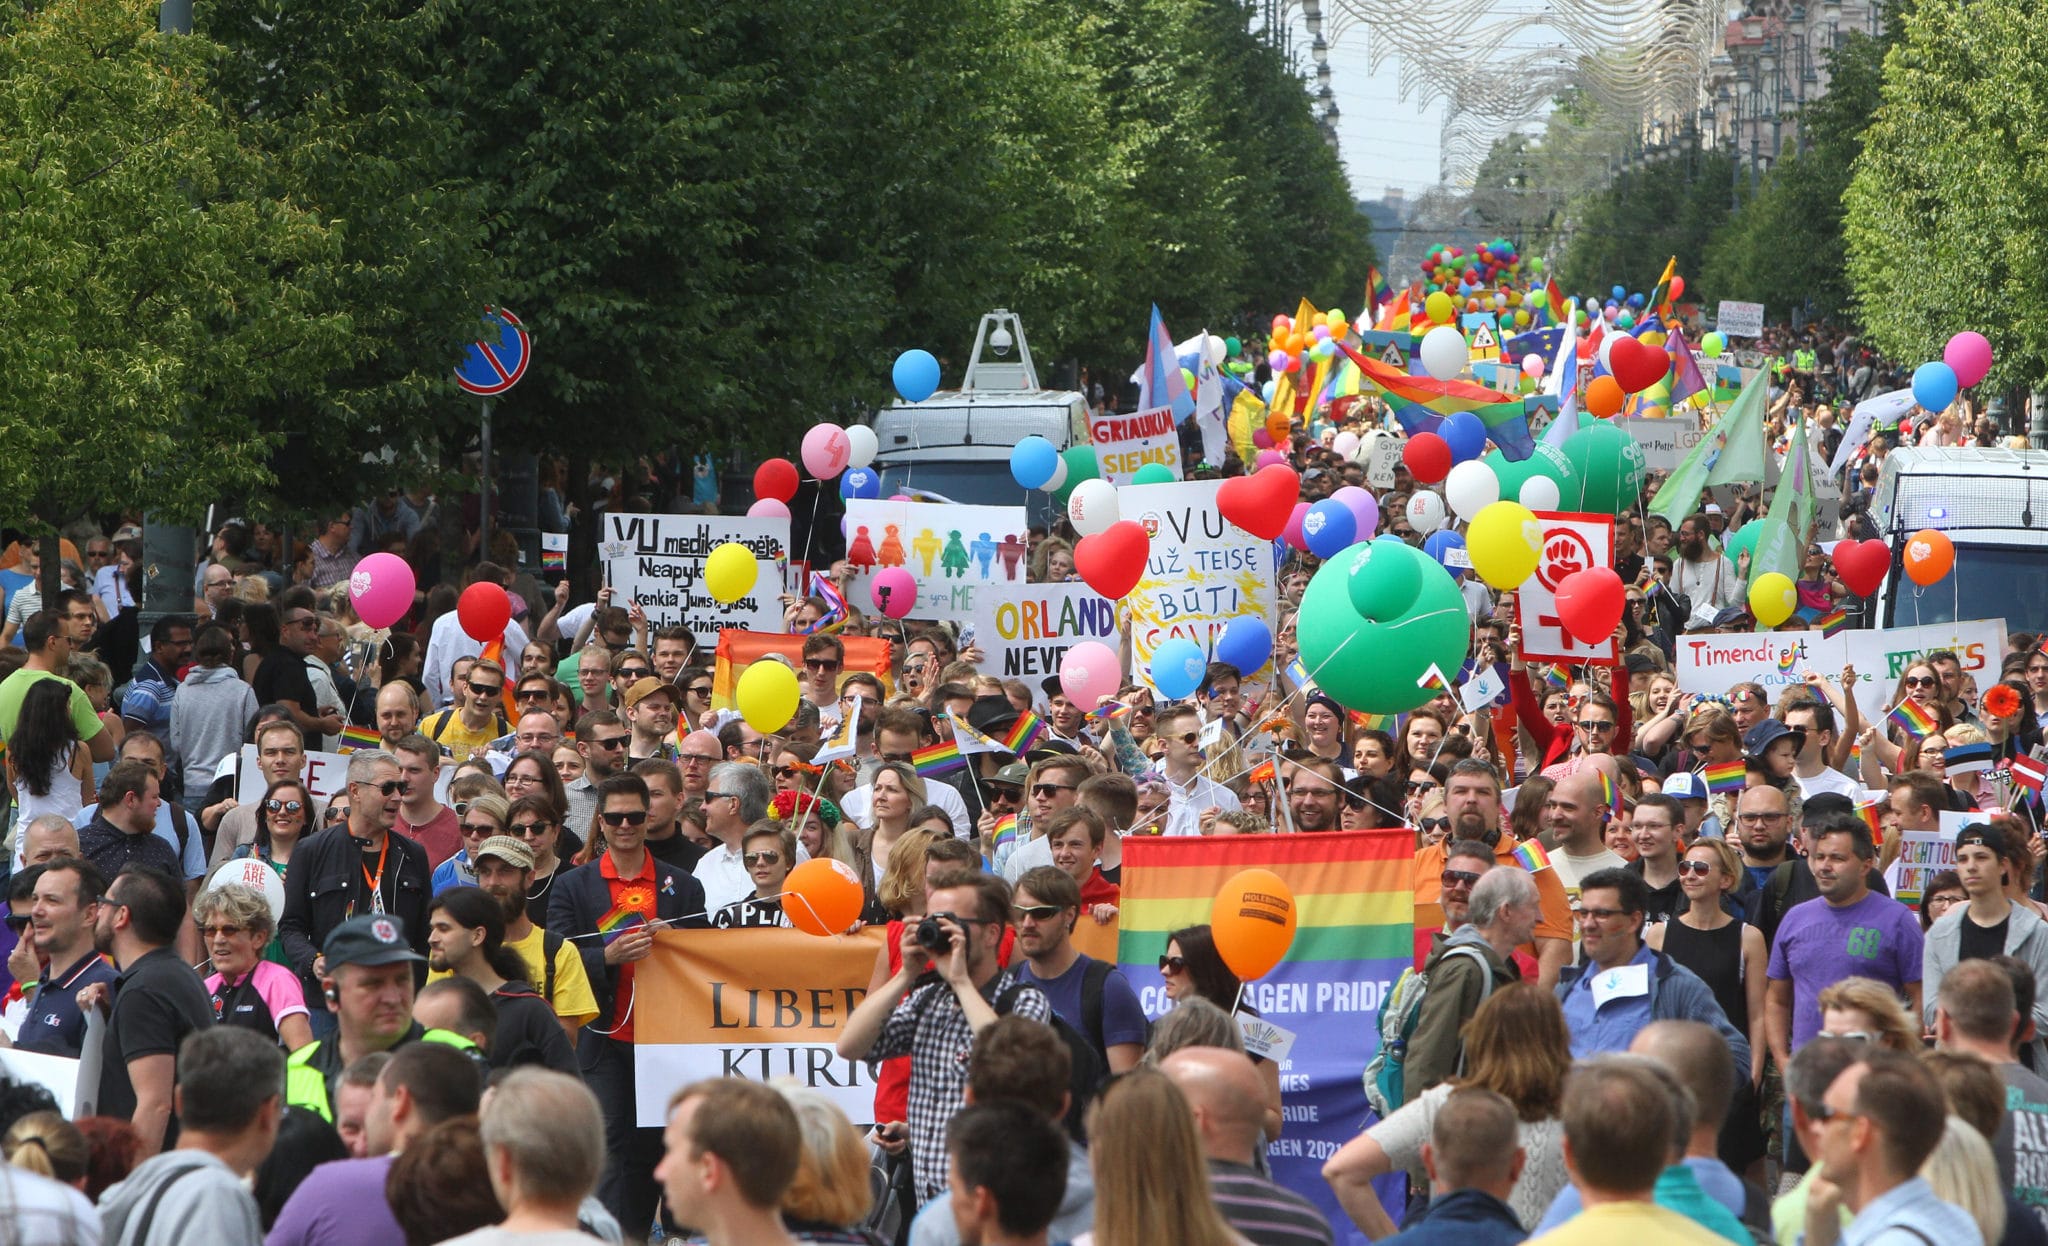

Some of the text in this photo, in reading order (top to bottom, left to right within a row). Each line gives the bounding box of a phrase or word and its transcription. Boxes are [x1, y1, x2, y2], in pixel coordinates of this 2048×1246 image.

[1092, 408, 1175, 444] GRIAUKIM
[1380, 441, 1405, 451] GYVE
[1373, 473, 1394, 481] KEN
[612, 516, 660, 553] VU
[1166, 507, 1224, 544] VU
[639, 557, 706, 588] Neapyk
[1148, 547, 1257, 576] UŽ TEISĘ
[634, 585, 678, 607] kenkia
[680, 588, 713, 613] Jums
[950, 585, 975, 611] ME
[1158, 586, 1238, 619] BŪTI
[1005, 646, 1074, 676] NEVE
[1688, 638, 1809, 667] Timendi et
[1901, 841, 1936, 864] RIGHT
[1936, 842, 1949, 864] TO
[242, 870, 265, 885] ARE
[244, 862, 265, 873] #WE
[1897, 868, 1921, 890] LOVE
[1847, 927, 1881, 960] 68
[1140, 981, 1391, 1015] COAGEN PRIDE
[718, 1047, 879, 1088] KURI
[1279, 1074, 1310, 1092] MES
[1282, 1105, 1320, 1122] RIDE
